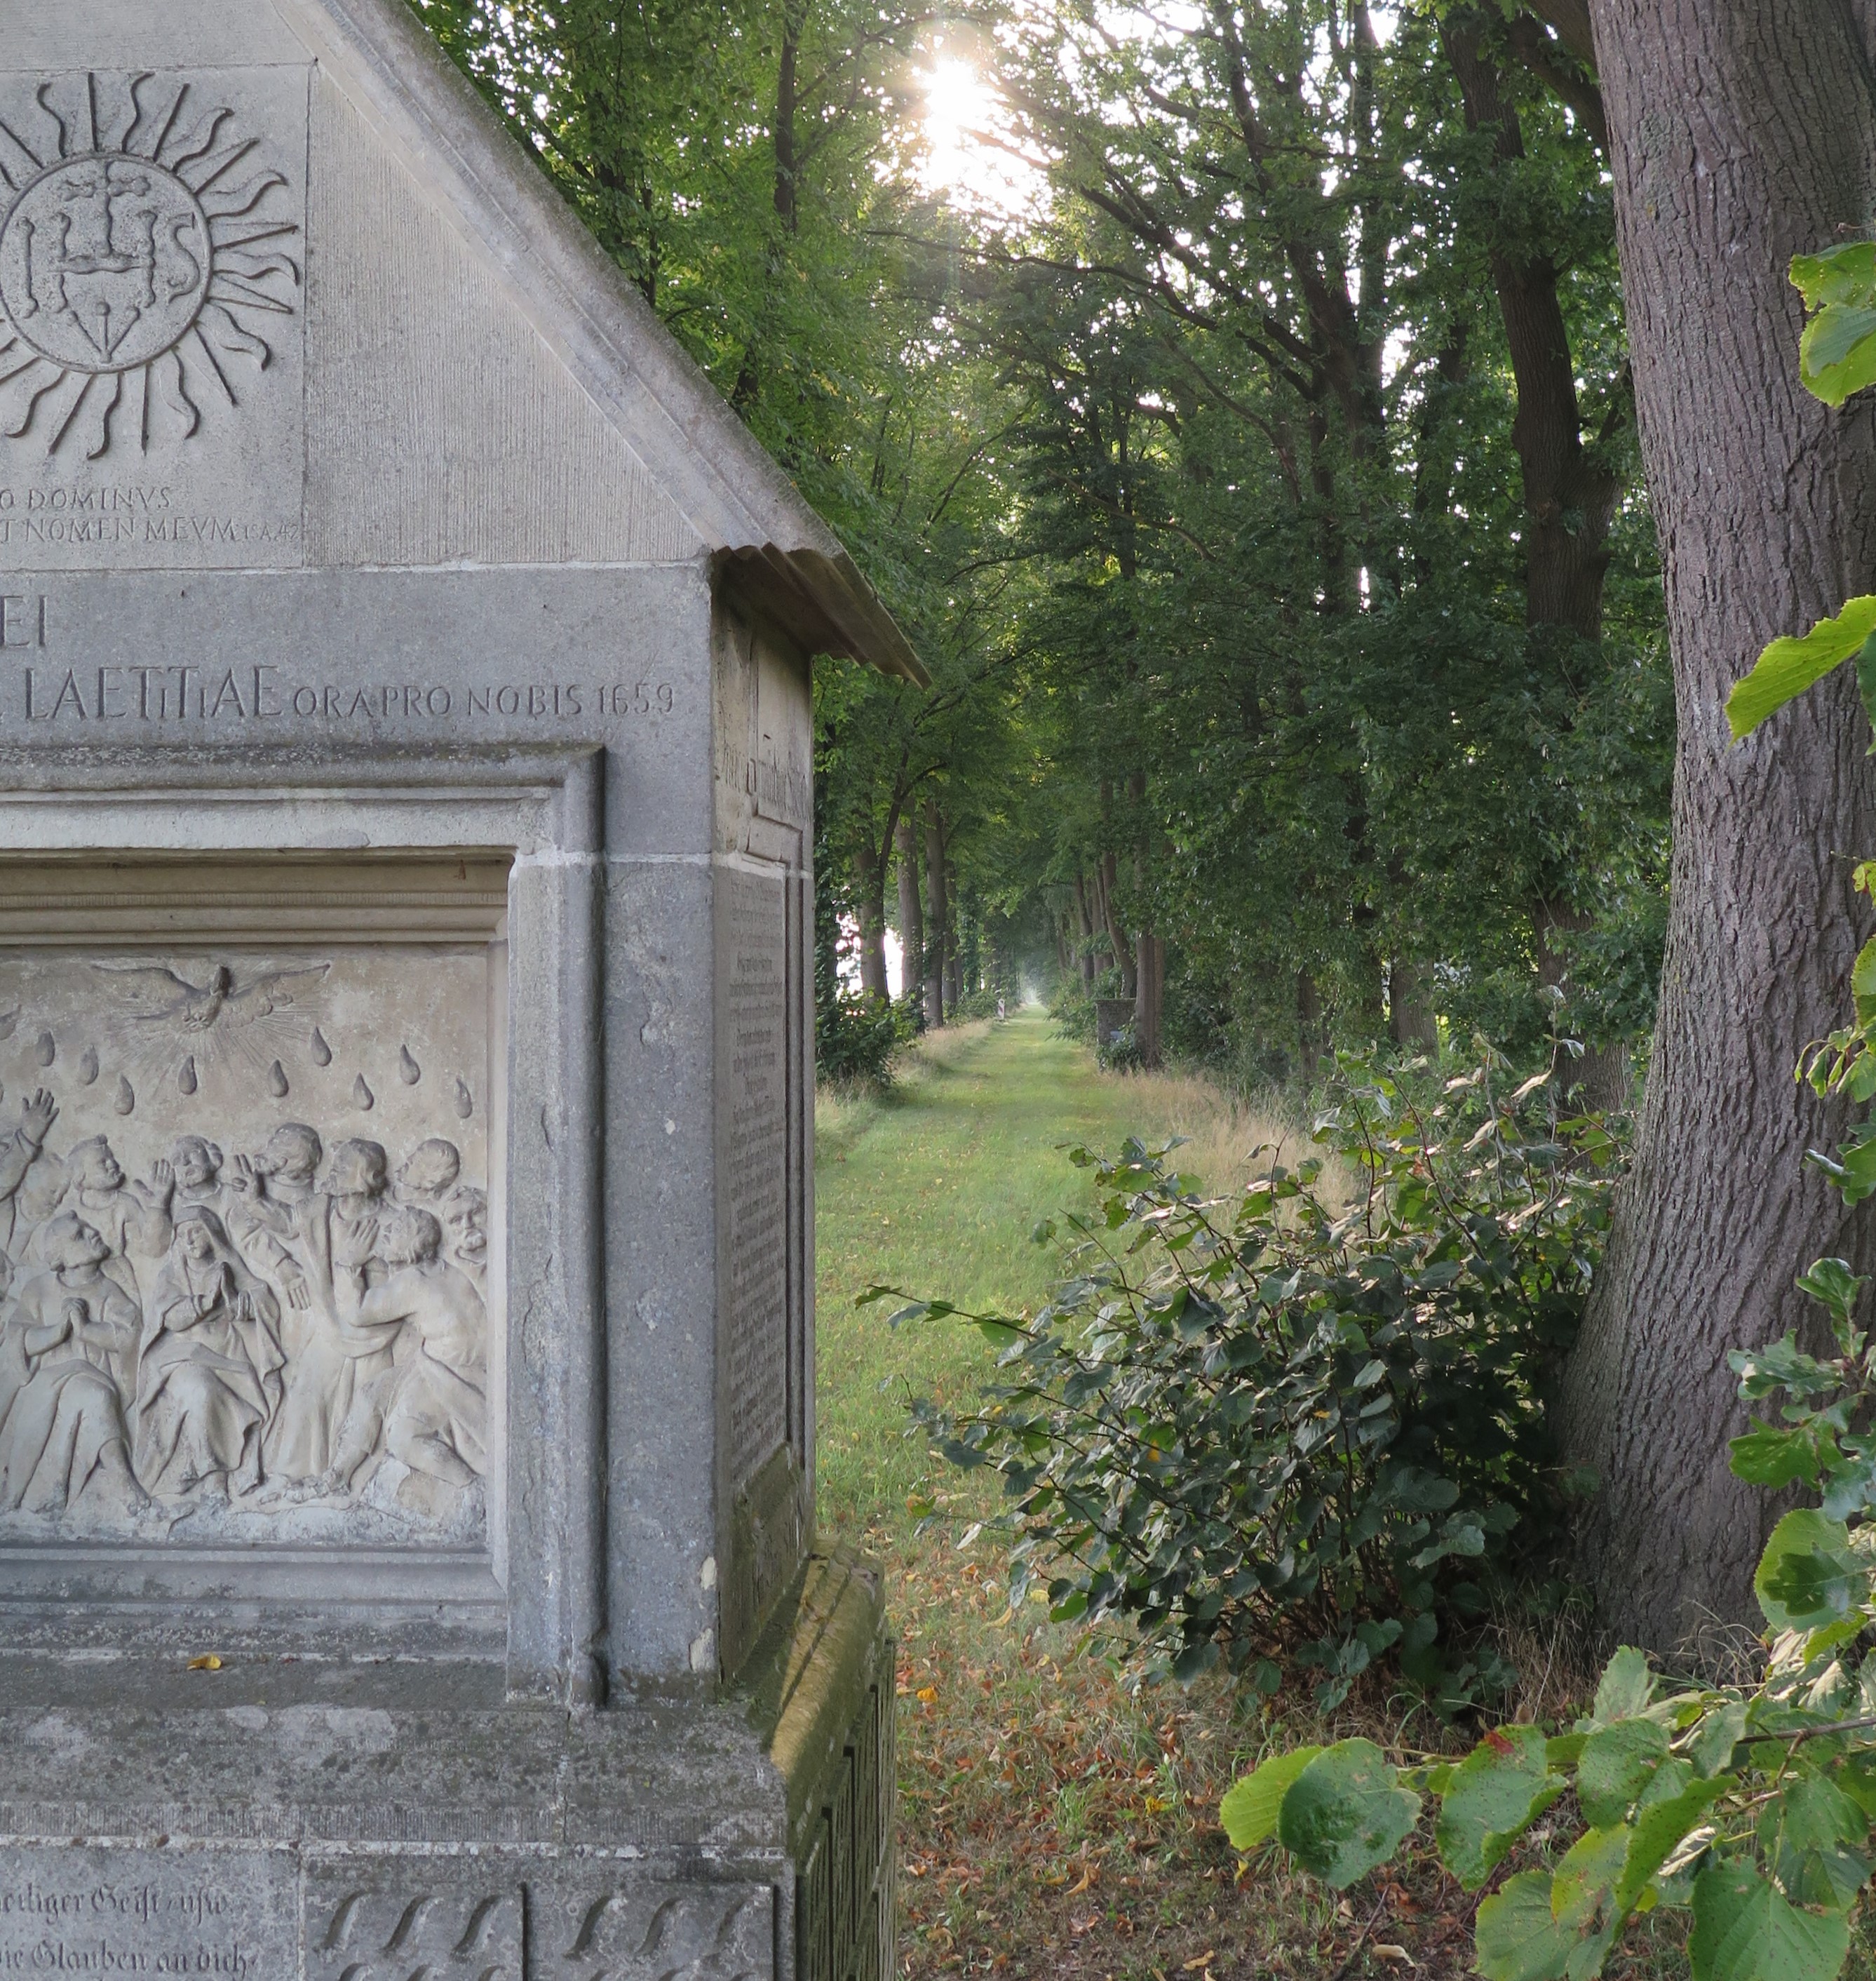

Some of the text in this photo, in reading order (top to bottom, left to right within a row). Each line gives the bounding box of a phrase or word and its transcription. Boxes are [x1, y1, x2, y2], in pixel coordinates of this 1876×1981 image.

[27, 487, 173, 512] DOMINVS
[25, 516, 135, 544] NOMEN
[293, 685, 374, 720] ORA
[379, 685, 452, 718] PRO
[467, 683, 583, 718] NOBIS
[597, 683, 674, 716] 1659
[0, 1882, 84, 1925] eiliger
